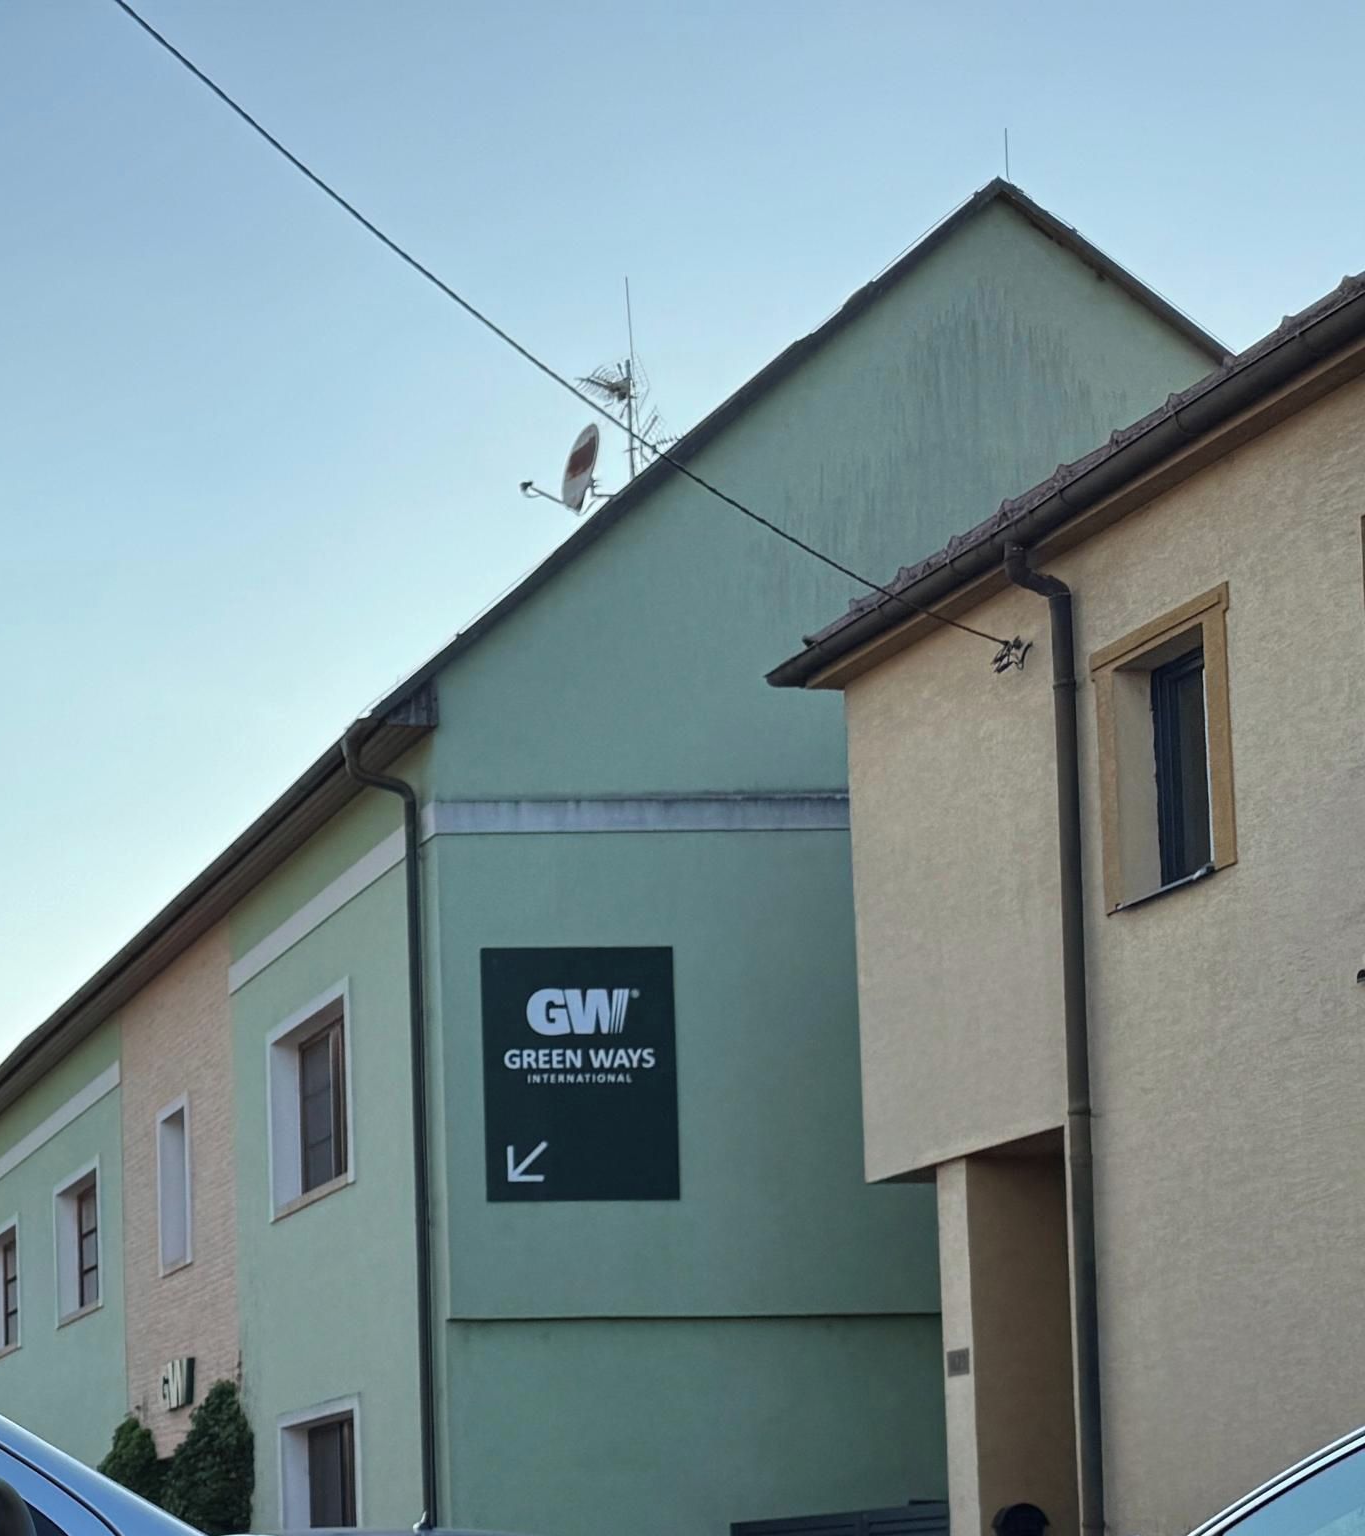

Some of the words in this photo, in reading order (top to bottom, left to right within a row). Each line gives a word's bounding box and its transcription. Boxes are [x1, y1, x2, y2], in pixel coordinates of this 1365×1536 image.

[503, 1049, 583, 1069] GREEN
[588, 1048, 656, 1069] WAYS
[526, 1073, 633, 1084] INTERNATIONAL
